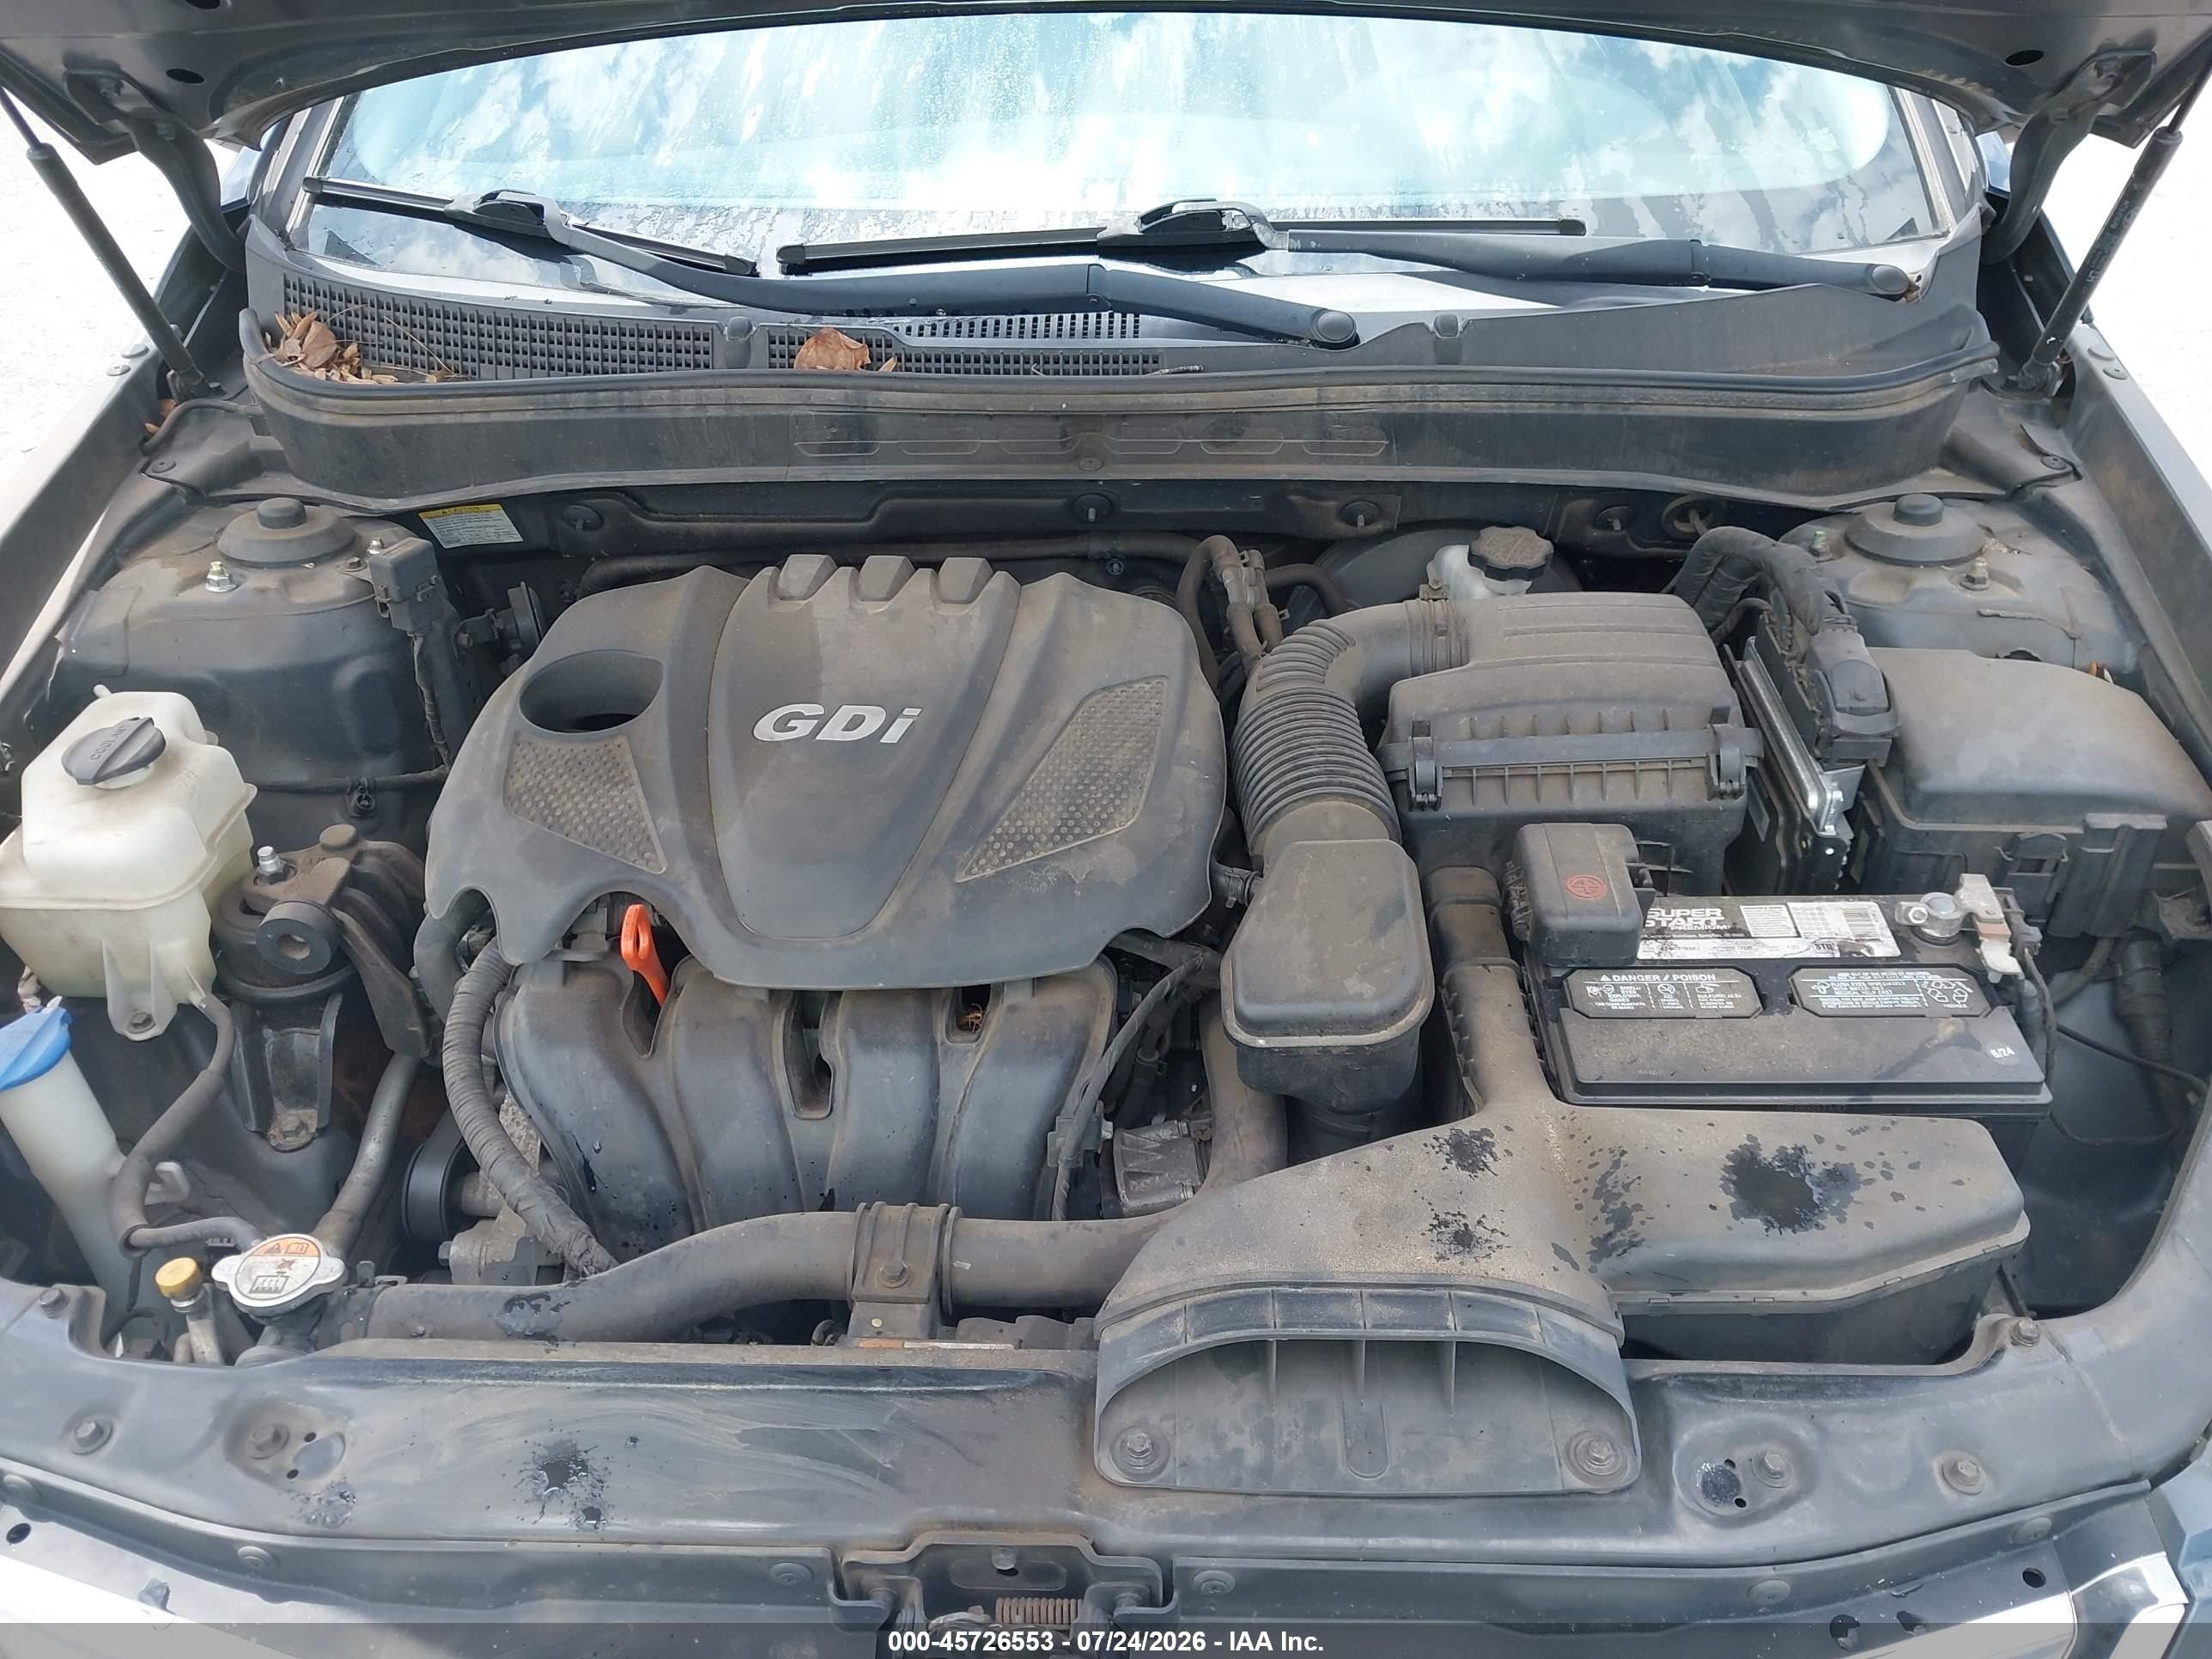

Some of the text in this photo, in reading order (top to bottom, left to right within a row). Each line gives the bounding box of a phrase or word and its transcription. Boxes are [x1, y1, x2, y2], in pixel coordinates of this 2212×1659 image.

[752, 702, 923, 744] GDi
[89, 725, 131, 760] COOLANT
[1648, 908, 1723, 918] SUPER
[1644, 916, 1725, 928] START
[1672, 973, 1717, 981] POISON
